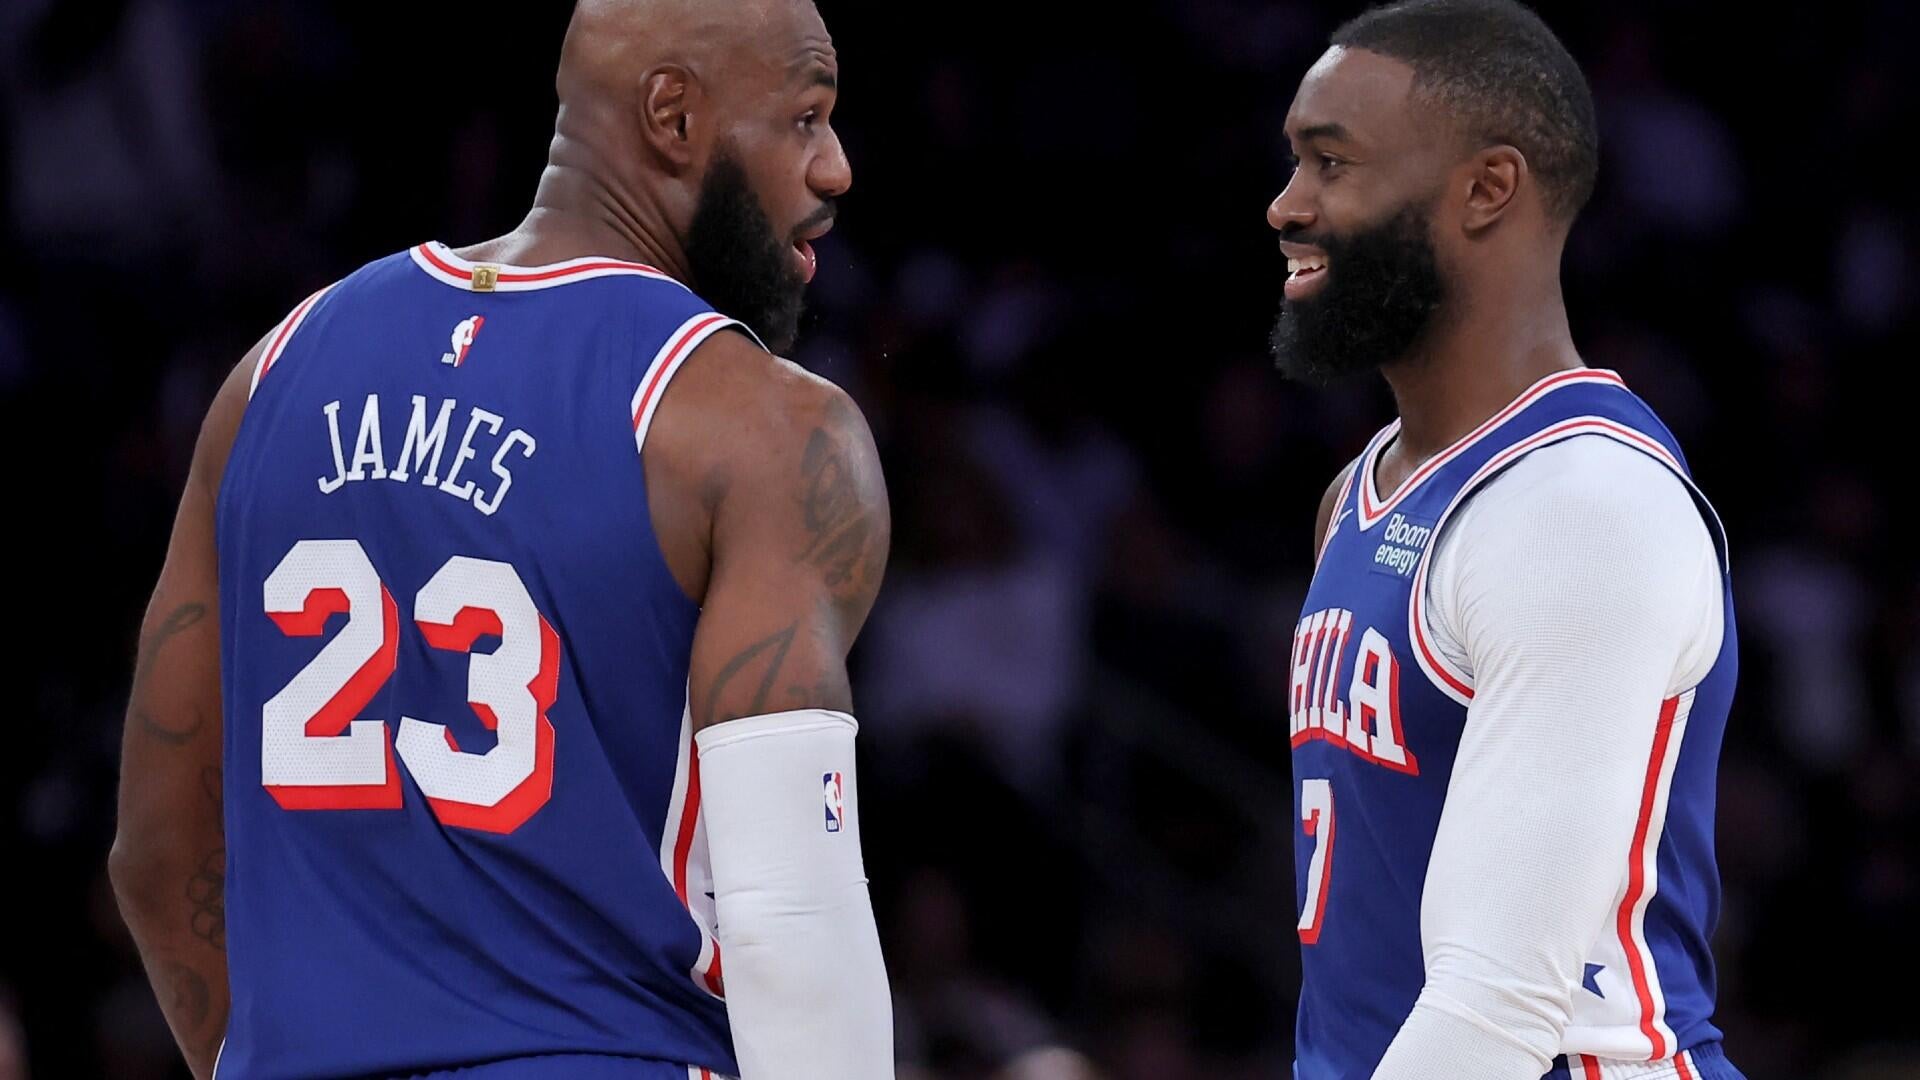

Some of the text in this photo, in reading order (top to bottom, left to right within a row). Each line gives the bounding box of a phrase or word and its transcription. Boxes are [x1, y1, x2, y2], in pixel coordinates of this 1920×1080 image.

[318, 393, 536, 516] JAMES
[1374, 543, 1420, 577] energy
[1384, 513, 1430, 549] Bloom
[262, 539, 560, 834] 23
[1289, 608, 1419, 776] HILA
[1297, 779, 1336, 944] 7
